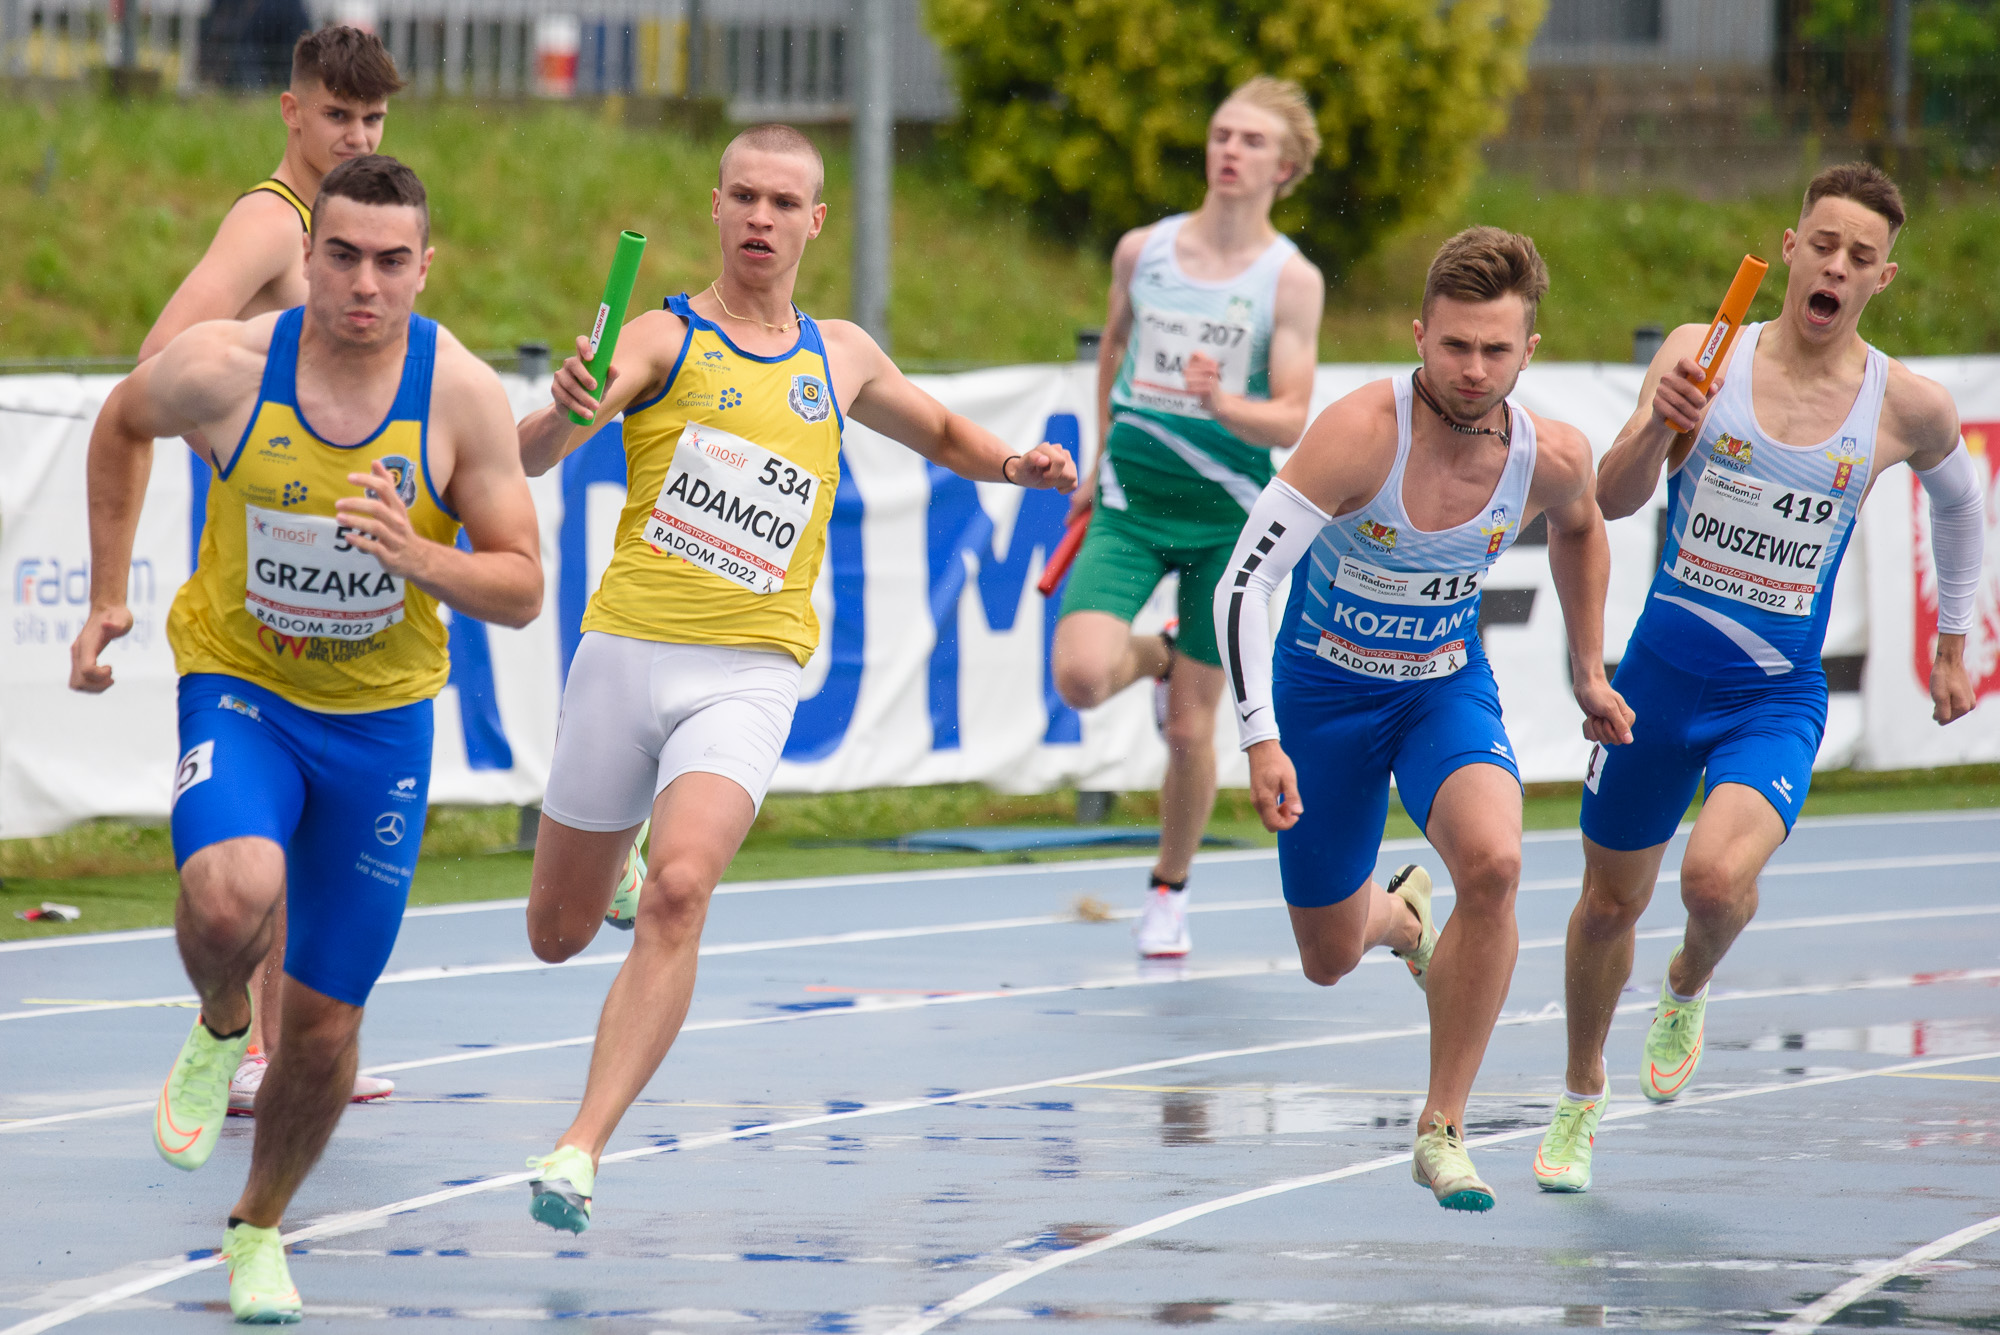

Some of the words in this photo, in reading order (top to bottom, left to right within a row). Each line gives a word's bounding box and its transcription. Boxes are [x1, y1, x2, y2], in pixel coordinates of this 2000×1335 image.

[1200, 323, 1246, 347] 207
[1708, 325, 1727, 356] polanik
[676, 398, 714, 408] Ostrowski
[687, 391, 714, 401] Powiat
[706, 443, 749, 469] mosir
[758, 457, 812, 506] 534
[1704, 474, 1761, 501] visitRadom.pl
[666, 472, 796, 550] ADAMCIO
[1772, 492, 1834, 525] 419
[272, 526, 318, 545] mosir
[654, 509, 676, 528] PZLA
[676, 519, 739, 555] MISTRZOSTWA
[738, 549, 767, 571] POLSKI
[766, 563, 784, 578] U20
[1353, 532, 1394, 556] GDAŃSK
[1691, 512, 1822, 570] OPUSZEWICZ
[653, 525, 716, 566] RADOM
[717, 557, 757, 585] 2022
[255, 557, 396, 602] GRZĄKA
[1343, 567, 1407, 593] visitRadom.pl
[1420, 572, 1478, 601] 415
[1682, 552, 1700, 566] PZLA
[1700, 556, 1766, 585] MISTRZOSTWA
[1766, 578, 1796, 591] POLSKI
[1796, 584, 1814, 594] U20
[1683, 566, 1743, 597] RADOM
[1749, 588, 1787, 608] 2022
[256, 607, 324, 636] RADOM
[330, 621, 375, 637] 2022
[1333, 602, 1468, 642] KOZELAN
[1325, 631, 1349, 650] PZLA
[1349, 643, 1416, 661] MISTRZOSTWA
[1444, 642, 1463, 654] U20
[1329, 646, 1395, 677] RADOM
[1400, 660, 1437, 677] 2022
[177, 750, 199, 790] 5
[1586, 744, 1600, 783] 4
